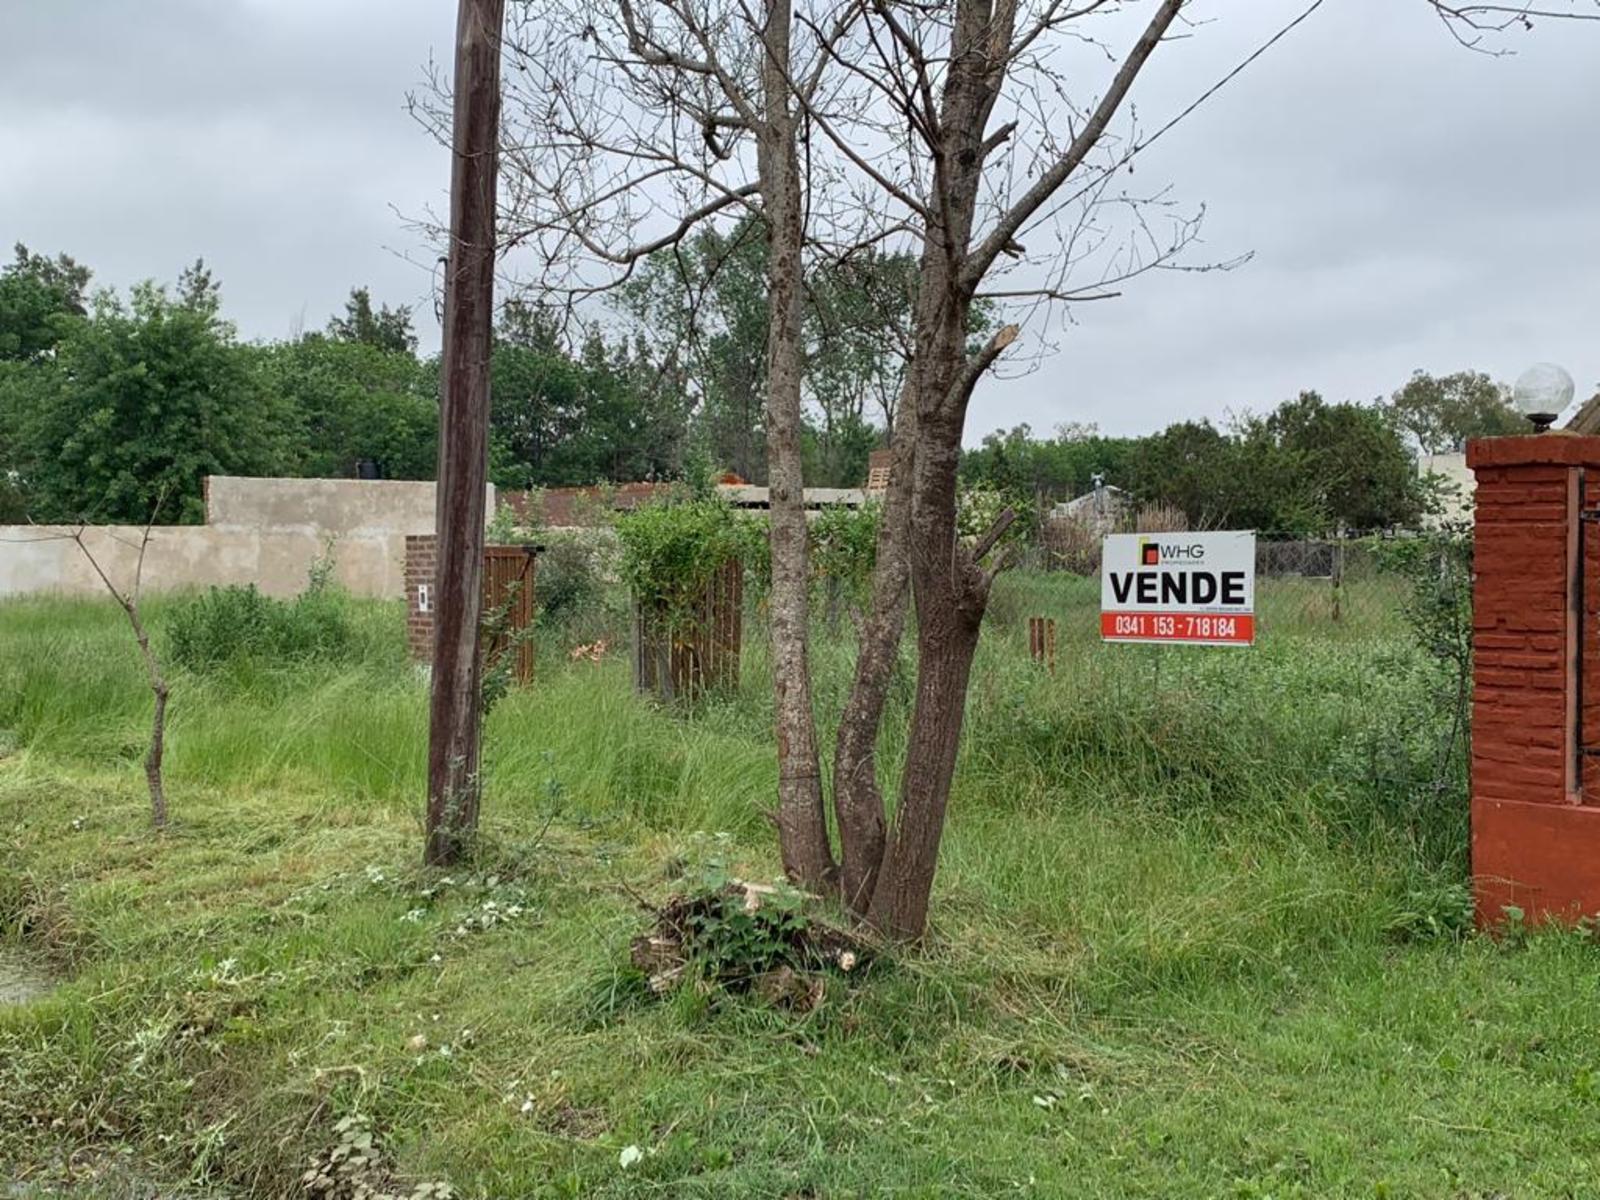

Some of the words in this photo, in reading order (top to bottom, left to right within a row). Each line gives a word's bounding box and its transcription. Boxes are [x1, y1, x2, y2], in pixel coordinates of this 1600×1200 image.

[1160, 544, 1205, 559] WHG
[1110, 571, 1245, 604] VENDE
[1115, 615, 1145, 634] 0341
